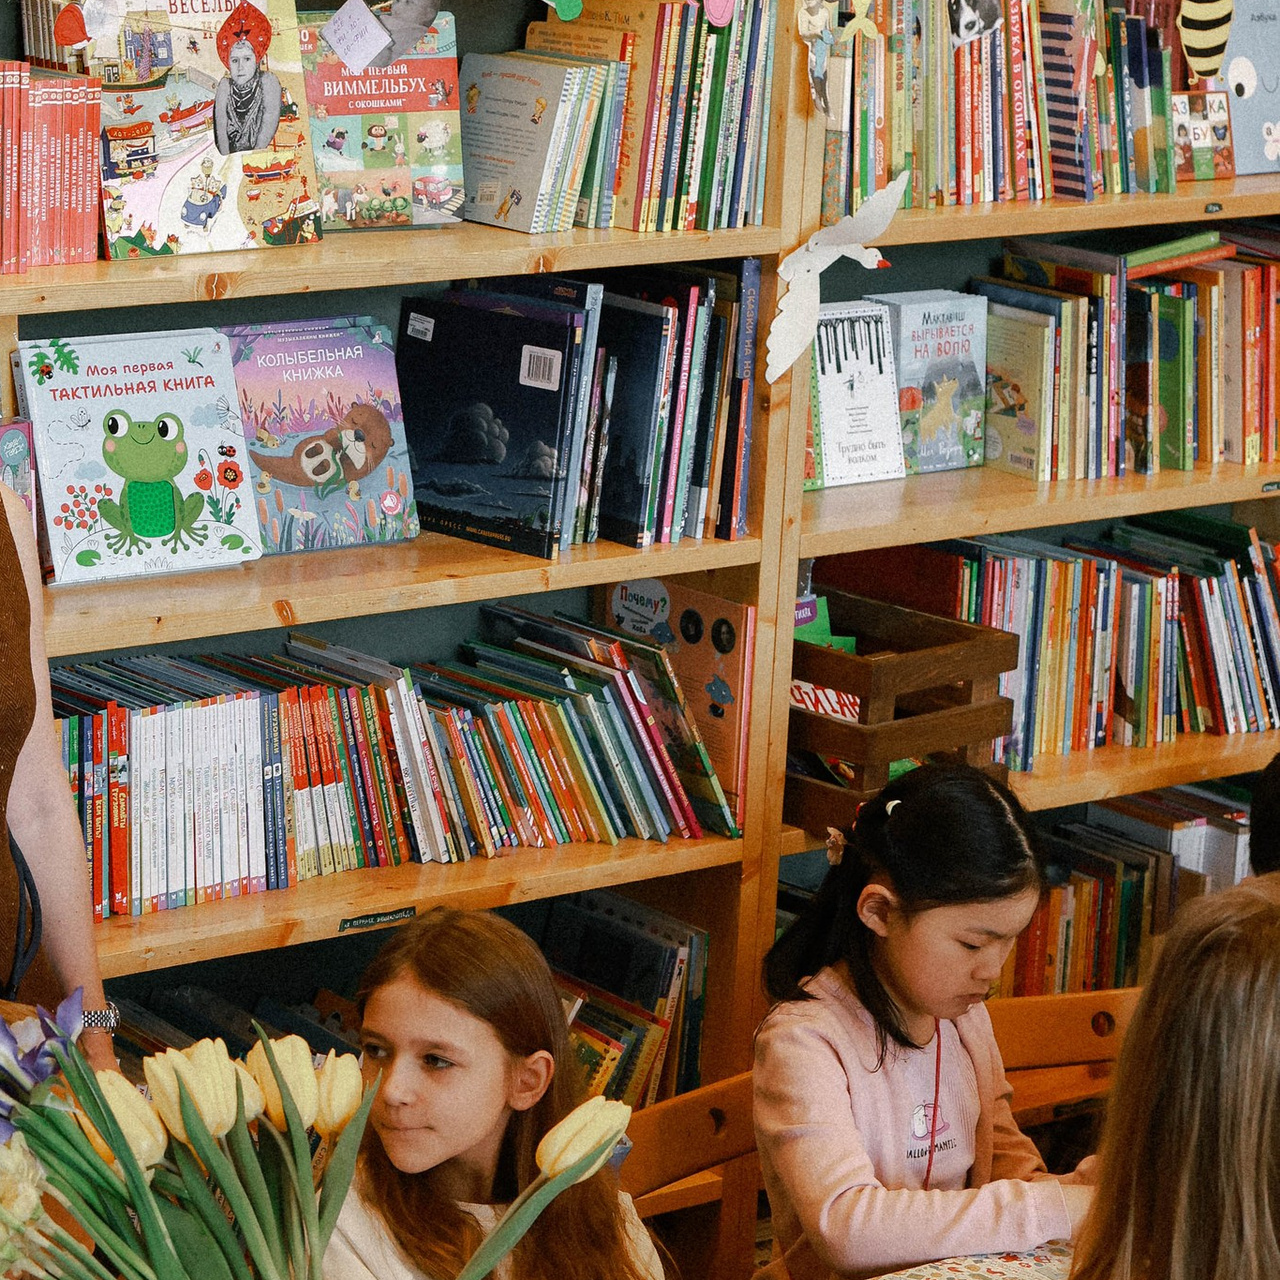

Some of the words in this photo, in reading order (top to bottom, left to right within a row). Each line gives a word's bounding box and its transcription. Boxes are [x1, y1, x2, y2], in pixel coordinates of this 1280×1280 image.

[323, 77, 428, 98] ВИММЕЛЬБУХ
[348, 99, 355, 109] С
[1013, 79, 1027, 161] ОКОШКАХ
[746, 288, 756, 334] СКАЗКИ
[911, 324, 975, 342] ВЫРЫВАЕТСЯ
[256, 345, 364, 369] КОЛЫБЕЛЬНАЯ
[744, 339, 752, 355] НА
[914, 344, 930, 358] НА
[936, 339, 971, 358] ВОЛЮ
[86, 363, 118, 378] Моя
[123, 361, 174, 379] первая
[282, 365, 344, 383] КНИЖКА
[49, 381, 157, 403] ТАКТИЛЬНАЯ
[163, 375, 216, 393] КНИГА
[619, 584, 668, 614] Почему?
